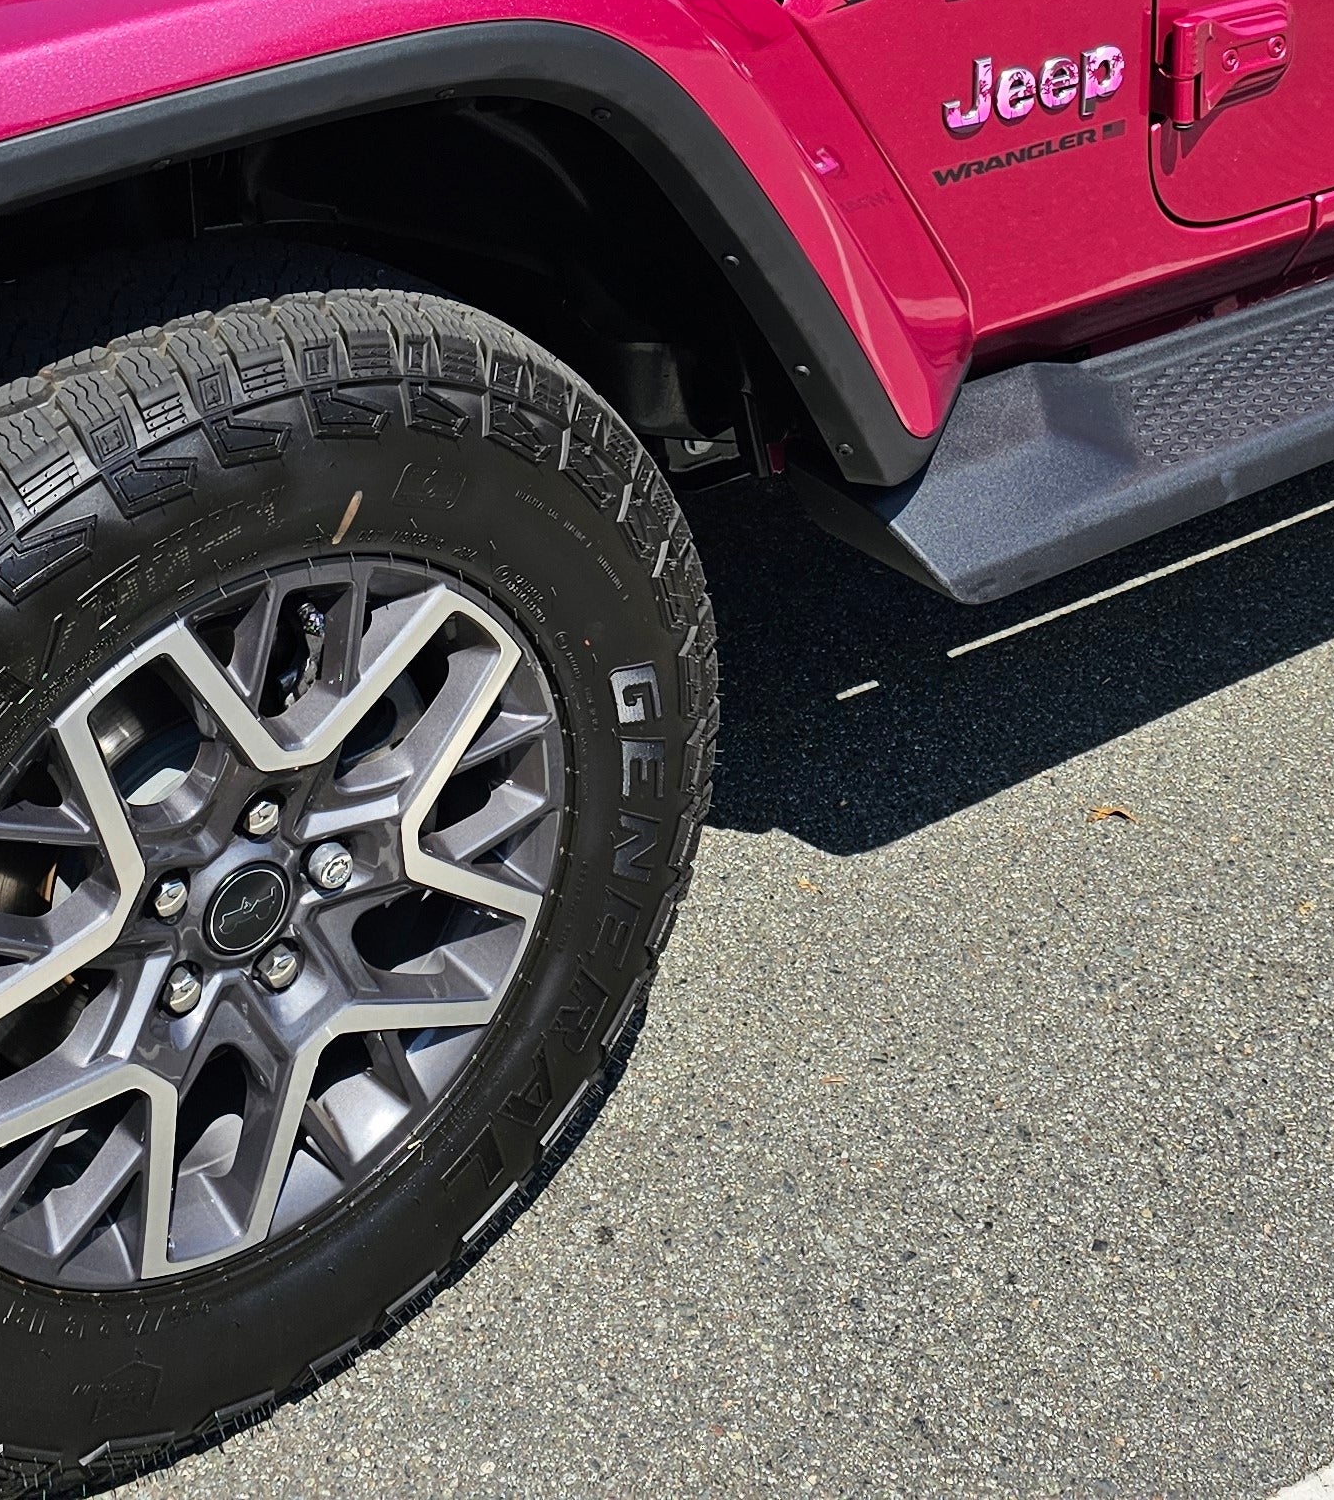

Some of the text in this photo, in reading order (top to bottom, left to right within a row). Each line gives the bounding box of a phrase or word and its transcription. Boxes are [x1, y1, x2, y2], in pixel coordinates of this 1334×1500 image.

[942, 45, 1125, 133] Jeep
[931, 128, 1097, 187] WRANGLER
[439, 661, 666, 1190] GENERAL
